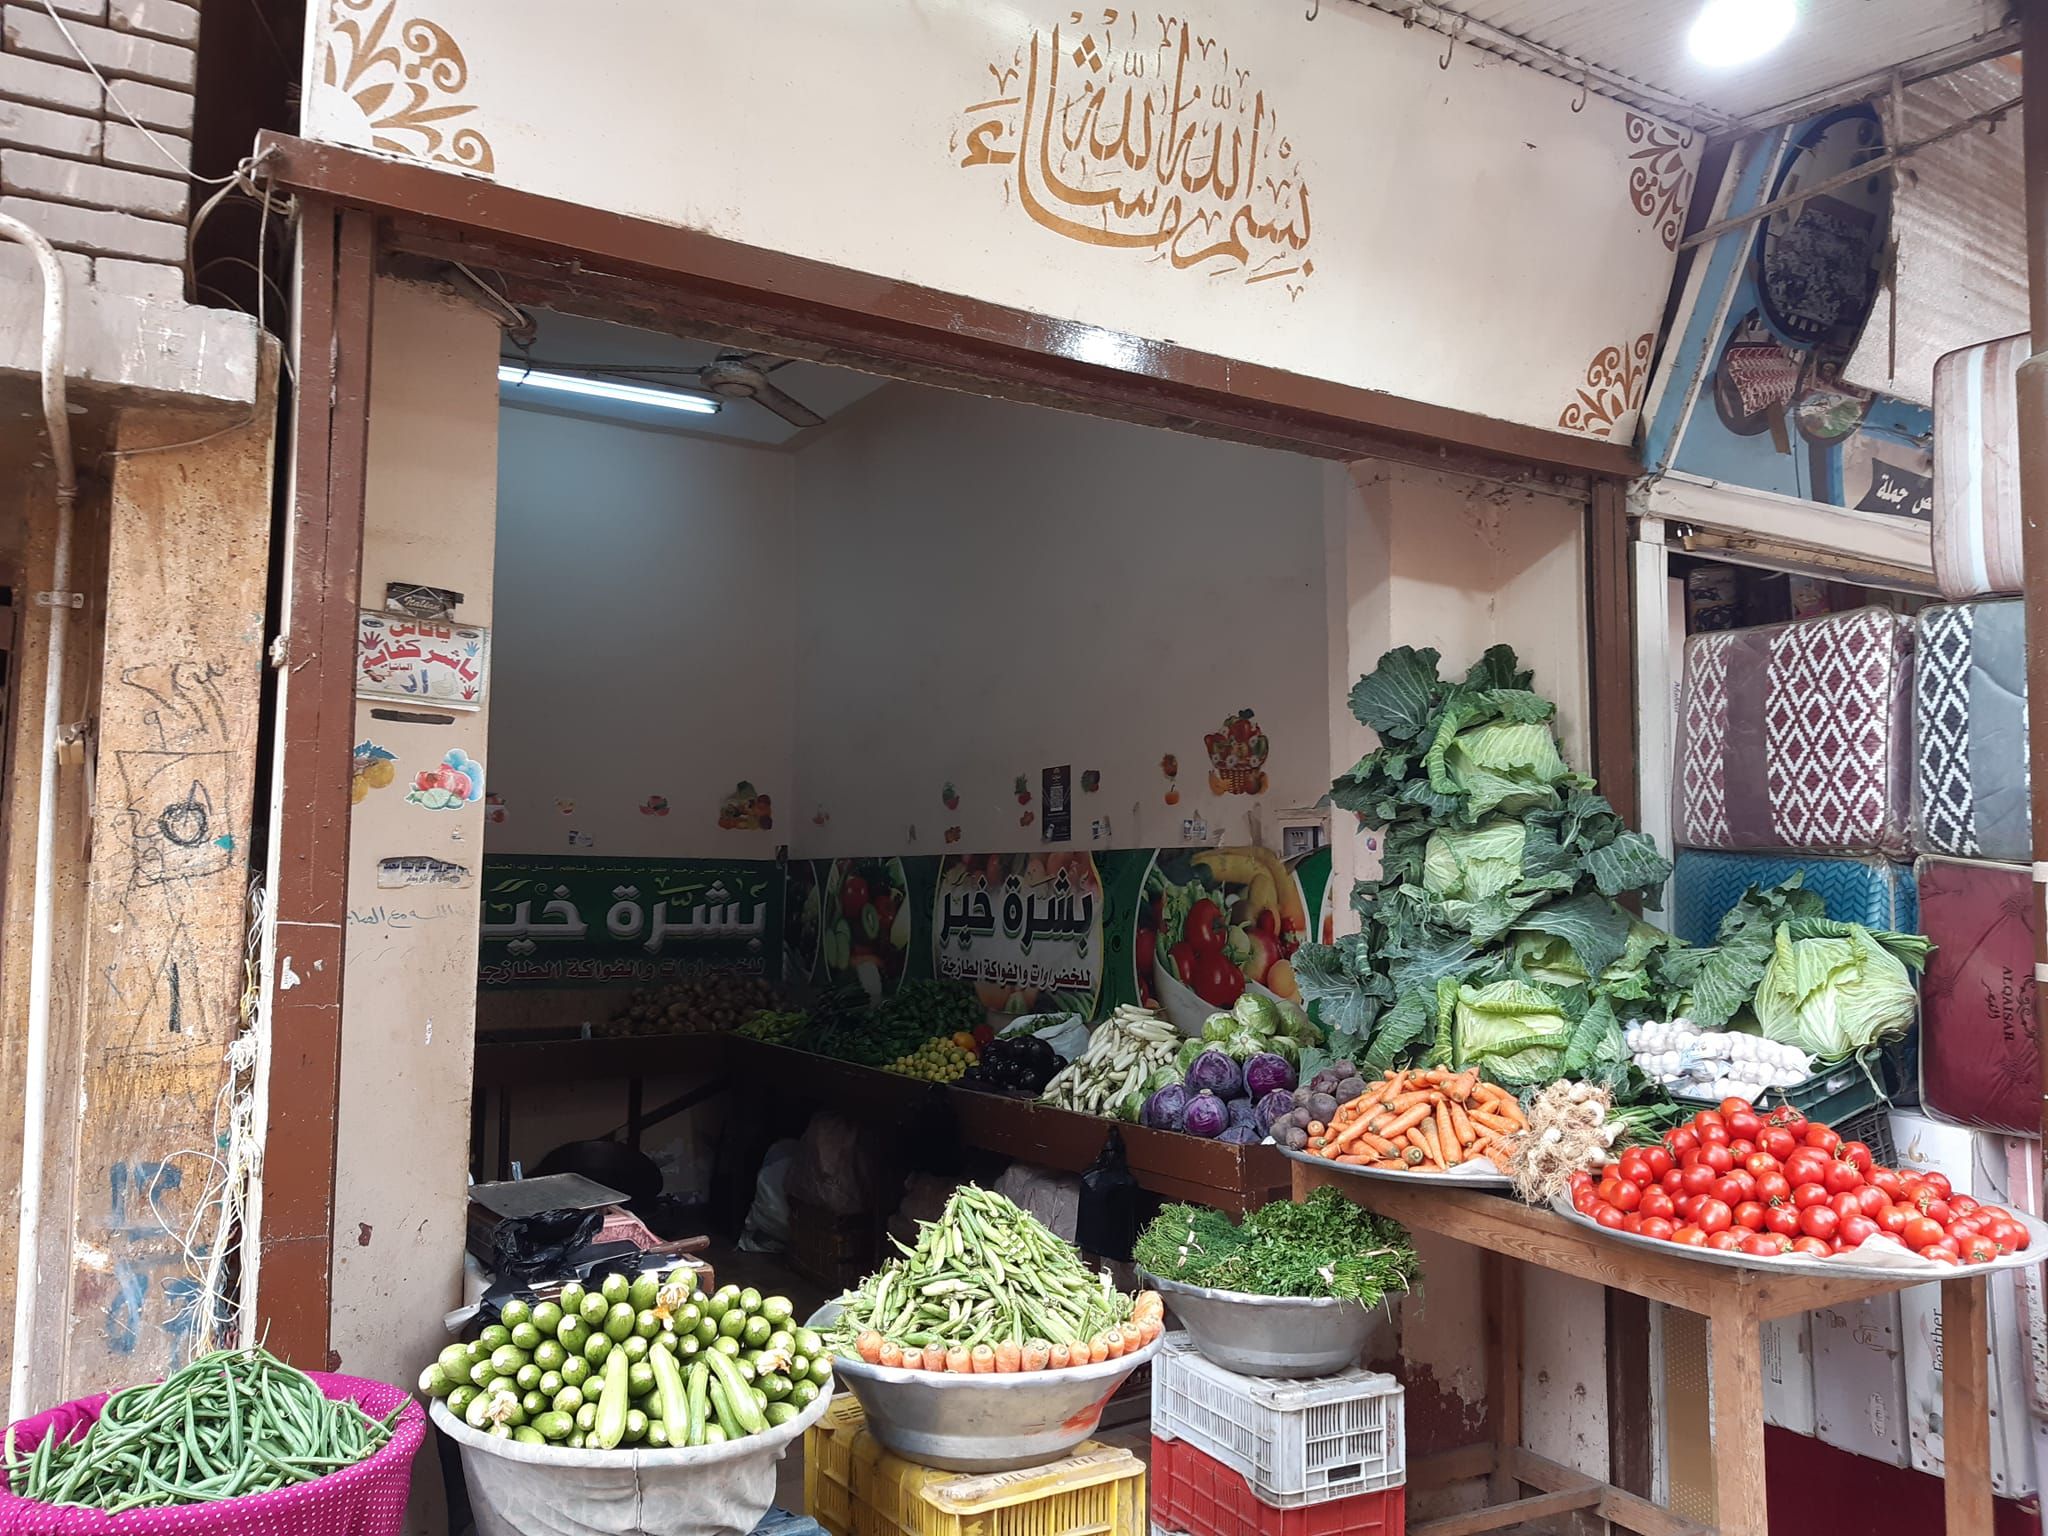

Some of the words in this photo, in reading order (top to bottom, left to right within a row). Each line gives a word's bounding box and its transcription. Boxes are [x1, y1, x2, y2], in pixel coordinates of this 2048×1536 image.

[1876, 475, 1908, 510] جملة
[480, 884, 588, 956] خي
[605, 879, 768, 952] بشرة
[940, 875, 995, 945] خير
[1003, 867, 1095, 953] بشرة
[479, 957, 563, 984] الطازج
[2002, 965, 2015, 1041] ALQAISAR
[1930, 1308, 1944, 1372] Feather
